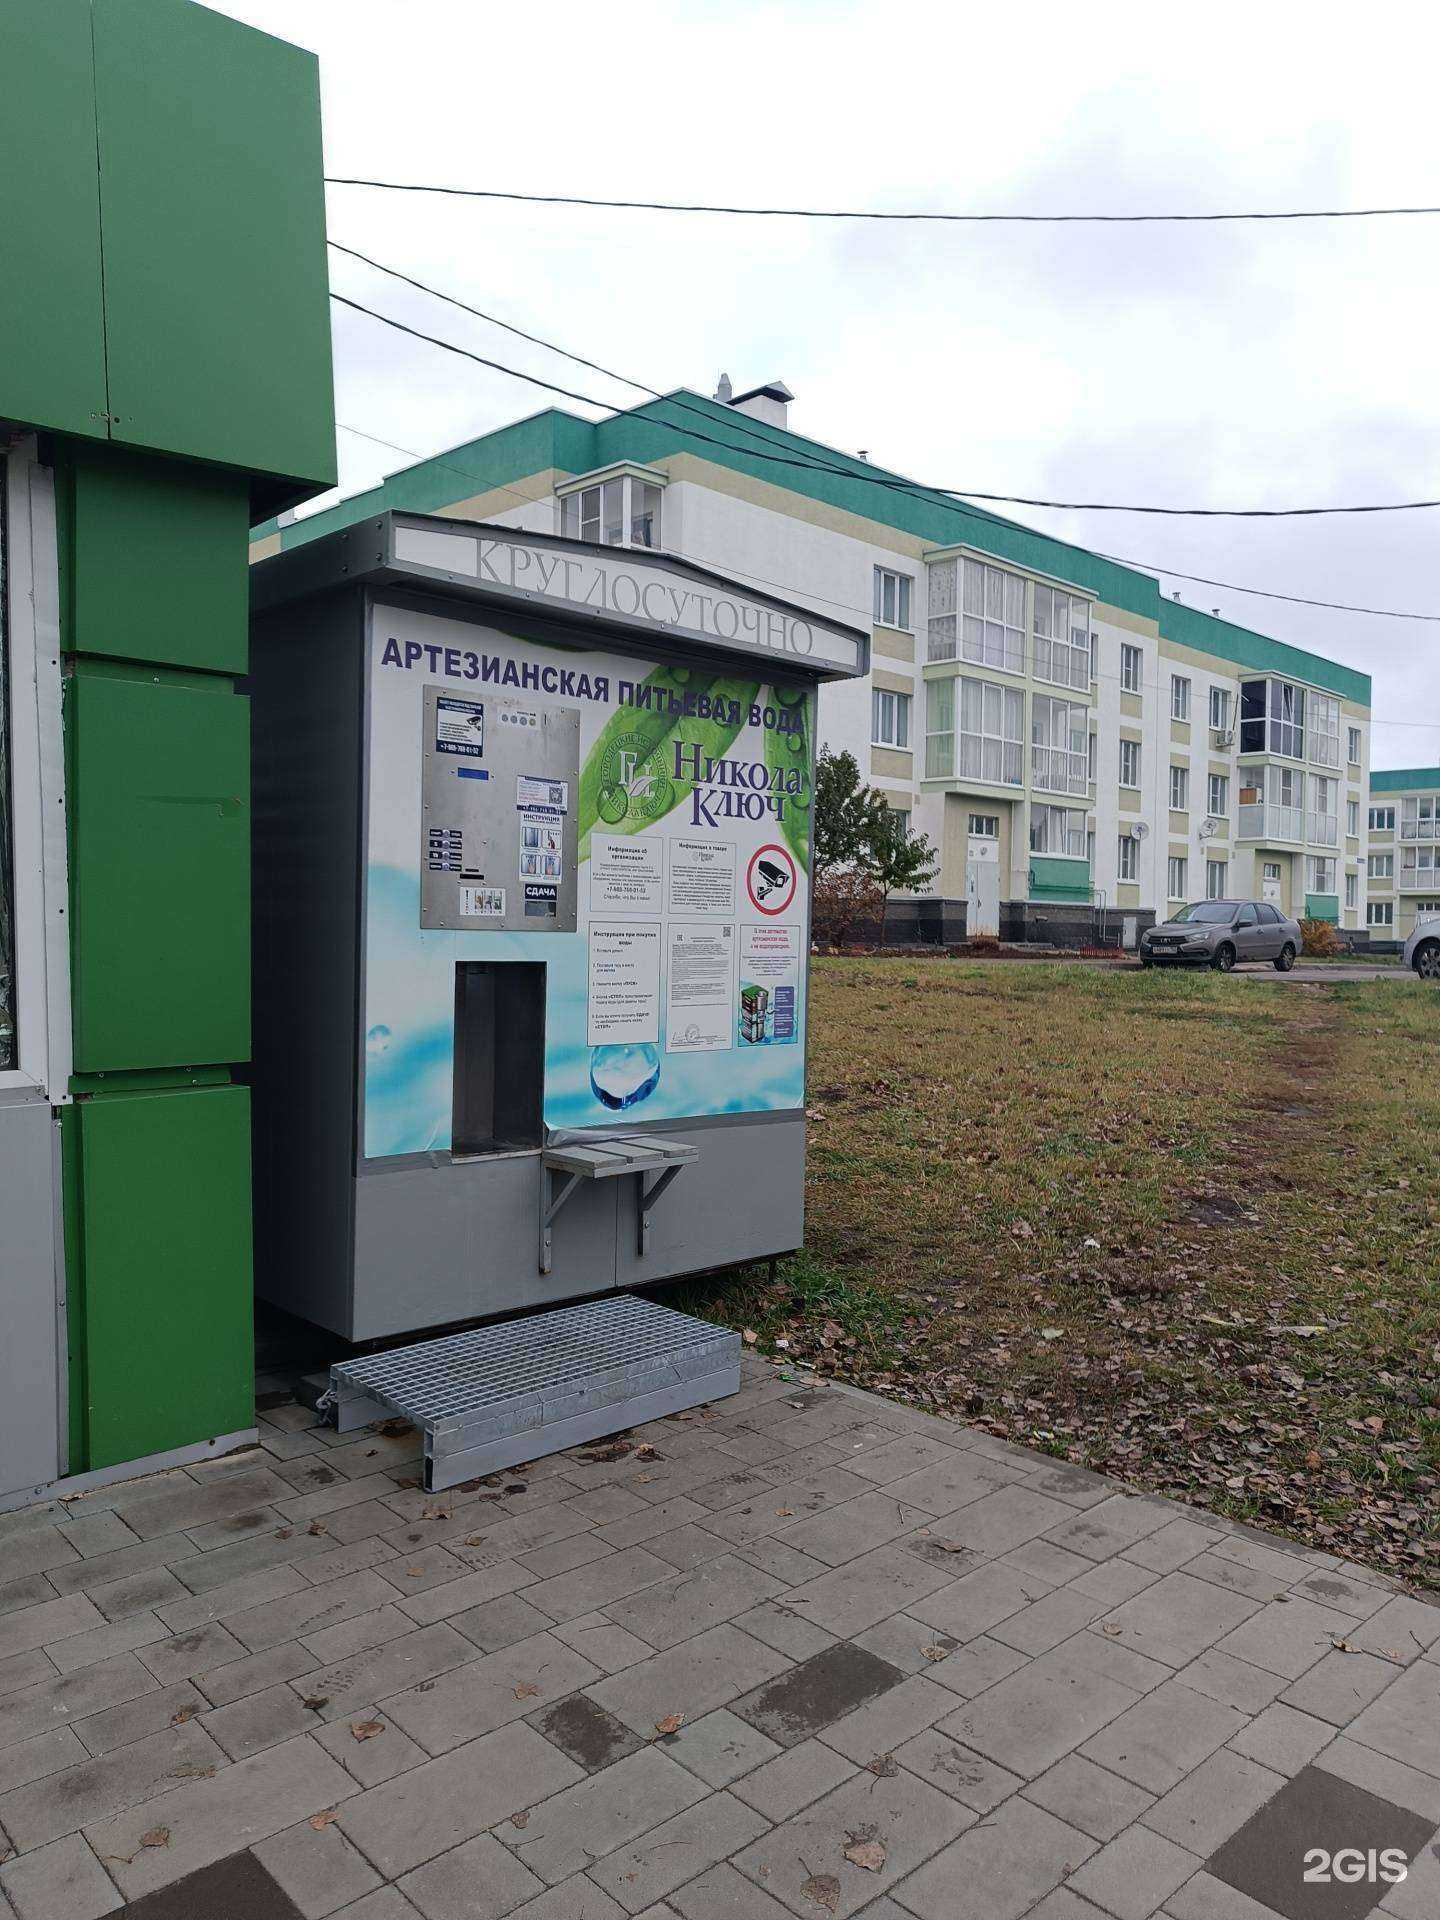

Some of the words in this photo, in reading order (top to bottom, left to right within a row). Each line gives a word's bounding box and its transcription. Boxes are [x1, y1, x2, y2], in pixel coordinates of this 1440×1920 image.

[475, 540, 814, 655] КРУГЛОСУТОЧНО
[381, 638, 610, 703] АРТЕЗИАНСКАЯ
[618, 680, 741, 725] ПИТЬЕВАЯ
[748, 703, 804, 736] ВОДА
[672, 740, 803, 795] Никола
[690, 787, 787, 828] Ключ
[526, 886, 556, 896] СДАЧА
